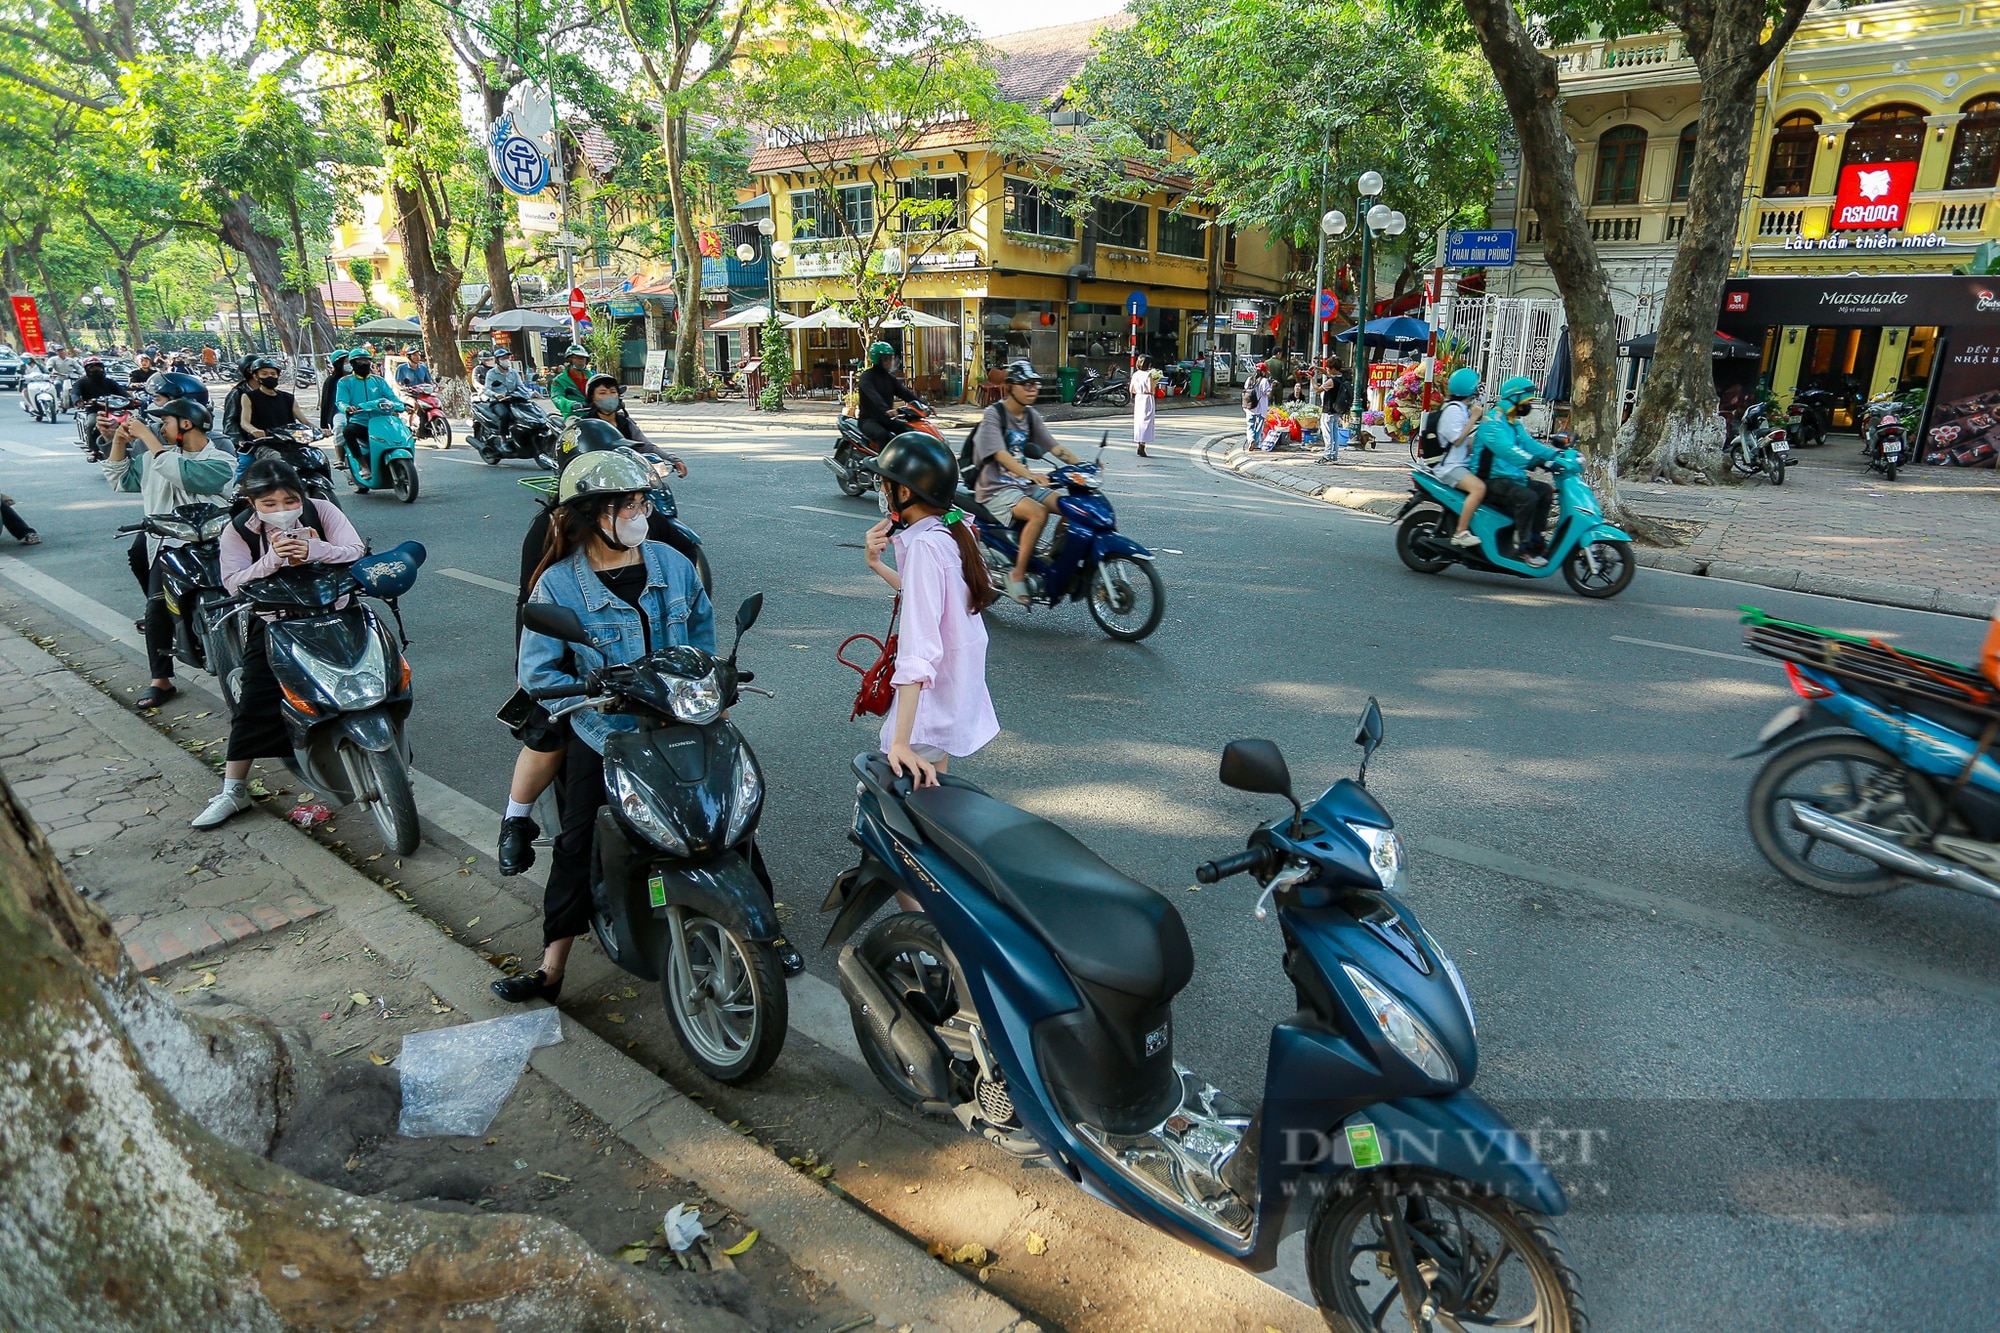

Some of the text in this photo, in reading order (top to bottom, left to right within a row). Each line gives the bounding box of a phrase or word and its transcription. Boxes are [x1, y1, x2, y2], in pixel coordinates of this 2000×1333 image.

[1839, 204, 1899, 223] ASHIMA
[1477, 233, 1499, 243] PHỐ
[1818, 231, 1849, 249] nấm
[1855, 233, 1897, 249] thiên
[1901, 232, 1947, 248] nhiên
[1451, 245, 1510, 261] PHAN ĐÌNH PHÙNG
[1819, 290, 1909, 305] Matsutake
[1954, 354, 1987, 365] NHẬT
[668, 739, 696, 749] HONDA
[893, 841, 941, 893] VISION
